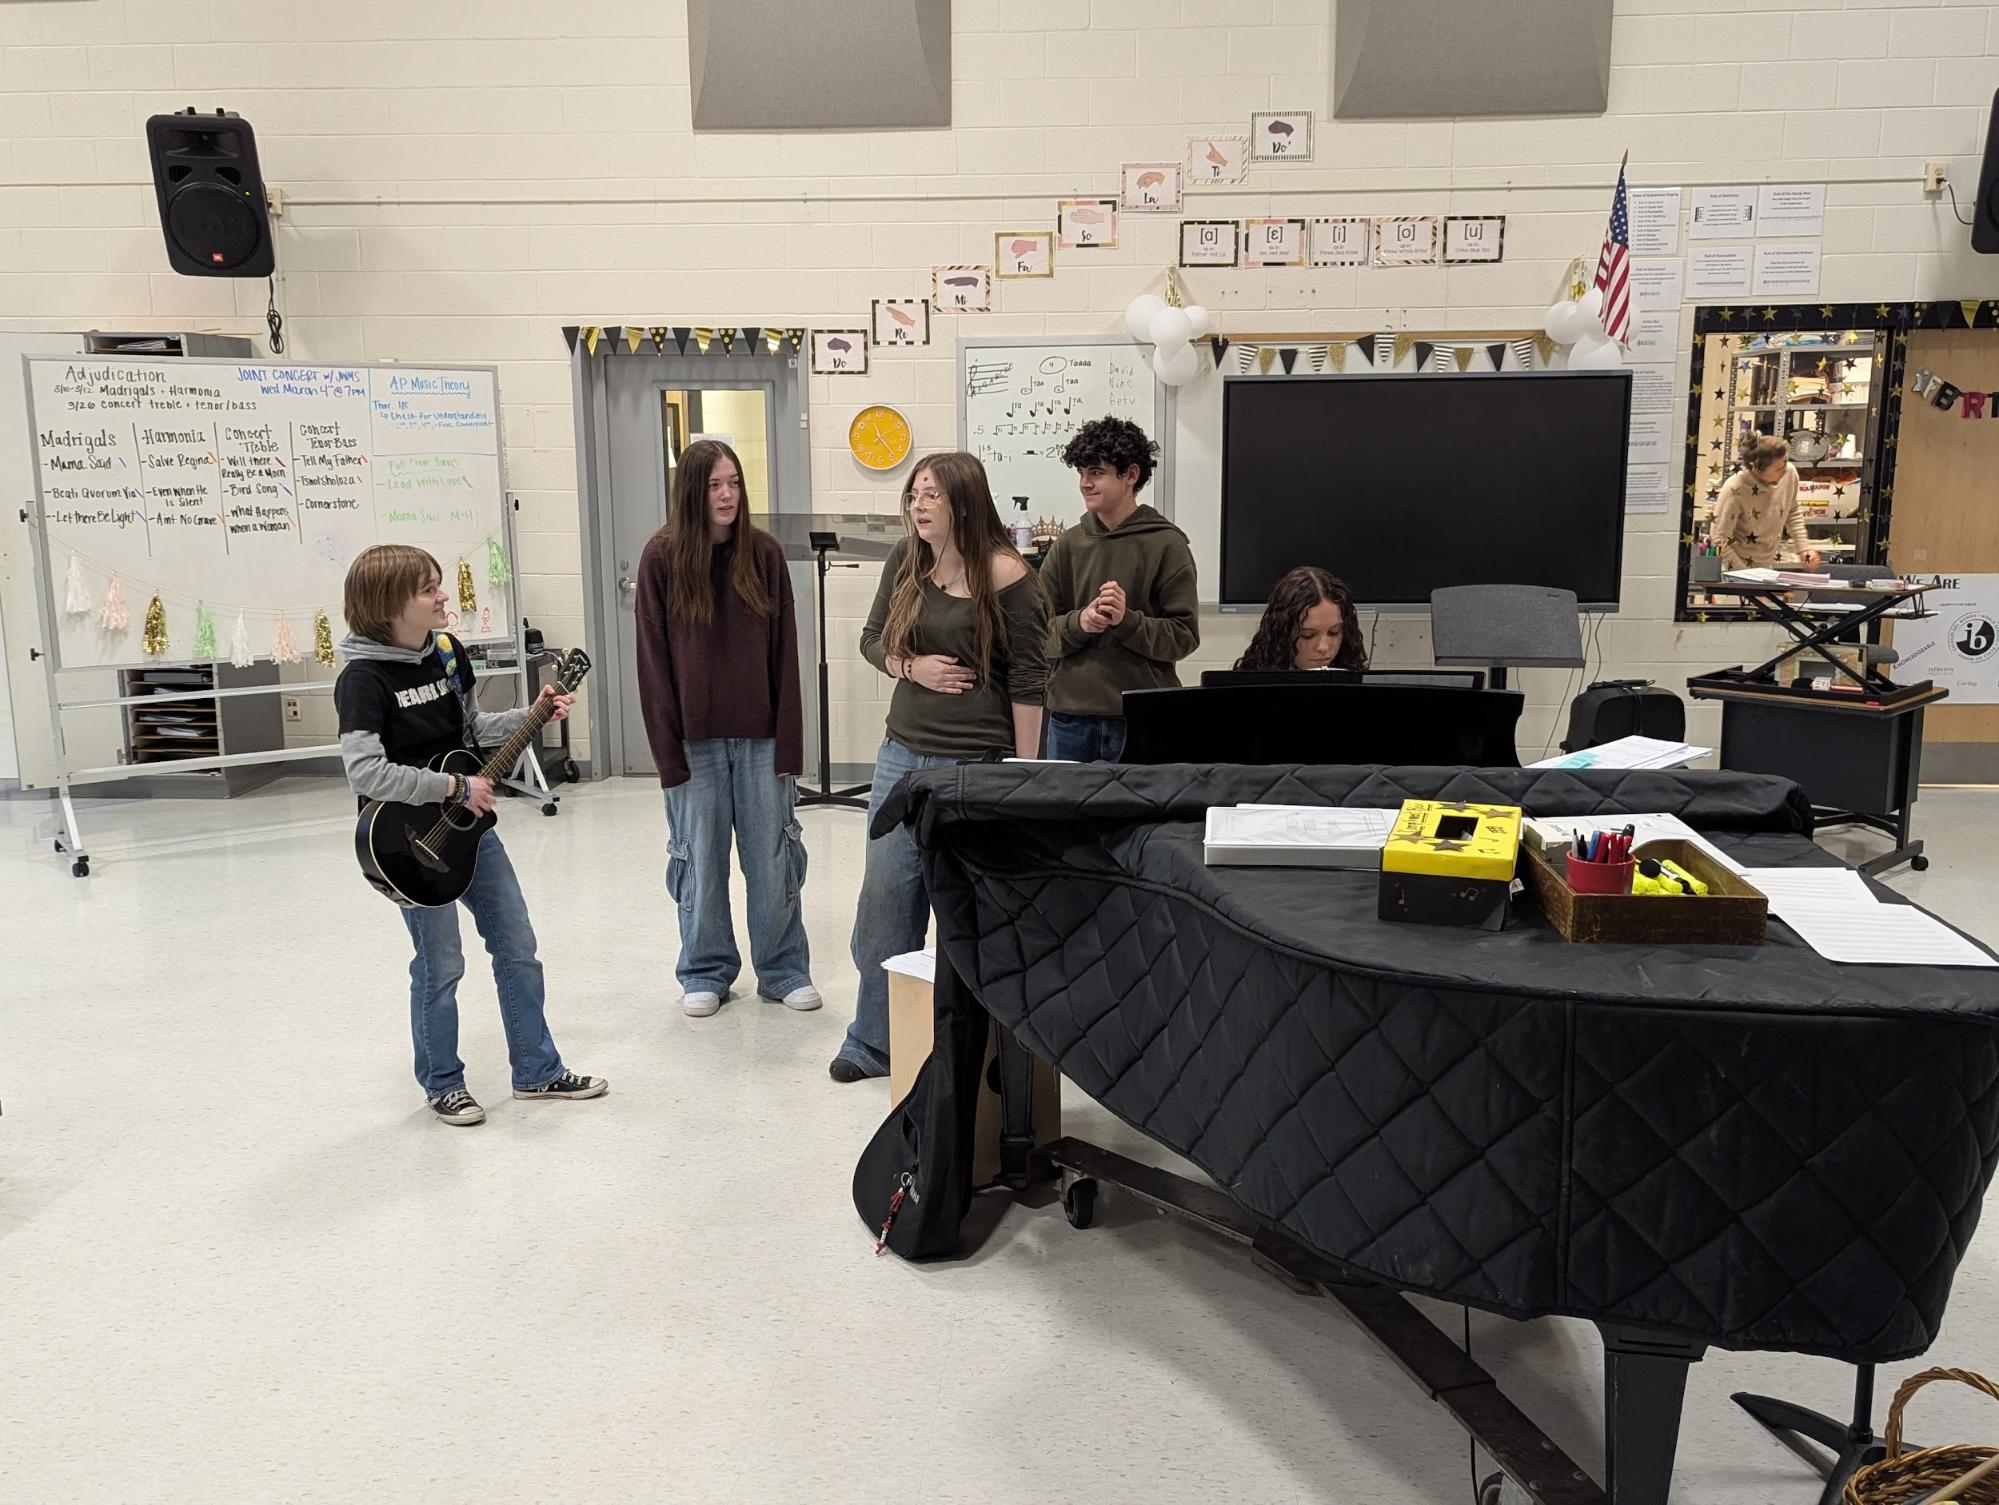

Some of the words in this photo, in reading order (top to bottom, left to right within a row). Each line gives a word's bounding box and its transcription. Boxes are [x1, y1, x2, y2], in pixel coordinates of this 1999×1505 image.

[1211, 165, 1221, 177] Ti
[1144, 193, 1158, 204] La
[1081, 230, 1093, 241] So
[1332, 225, 1346, 242] [i]
[1397, 224, 1416, 241] [o]
[1464, 223, 1483, 240] [u]
[1017, 262, 1032, 273] Fa
[954, 294, 968, 306] Mi
[895, 328, 908, 340] Re
[833, 358, 847, 369] Do
[65, 365, 167, 387] Adjudication
[236, 368, 267, 382] JOINT
[272, 368, 318, 383] CONCERT
[99, 384, 156, 399] Madrigals
[169, 384, 221, 398] Harmonia
[390, 376, 407, 391] AP
[411, 376, 437, 391] Music
[436, 376, 471, 399] Theory
[67, 400, 96, 411] 3/26
[225, 424, 272, 441] Concert
[300, 421, 341, 436] Concert
[40, 429, 117, 454] Madrigals
[142, 429, 206, 445] Harmonia
[239, 440, 279, 454] Treble
[50, 457, 87, 471] Mama
[148, 456, 174, 468] Salve
[178, 454, 212, 471] Regina
[227, 456, 247, 467] Will
[301, 454, 317, 466] Tell
[319, 454, 333, 470] My
[334, 453, 363, 466] Father
[52, 488, 79, 499] Beati
[230, 484, 252, 497] Bird
[256, 483, 278, 499] Song
[305, 497, 359, 510] Cornerstone
[180, 513, 193, 525] No
[255, 505, 289, 520] Happens
